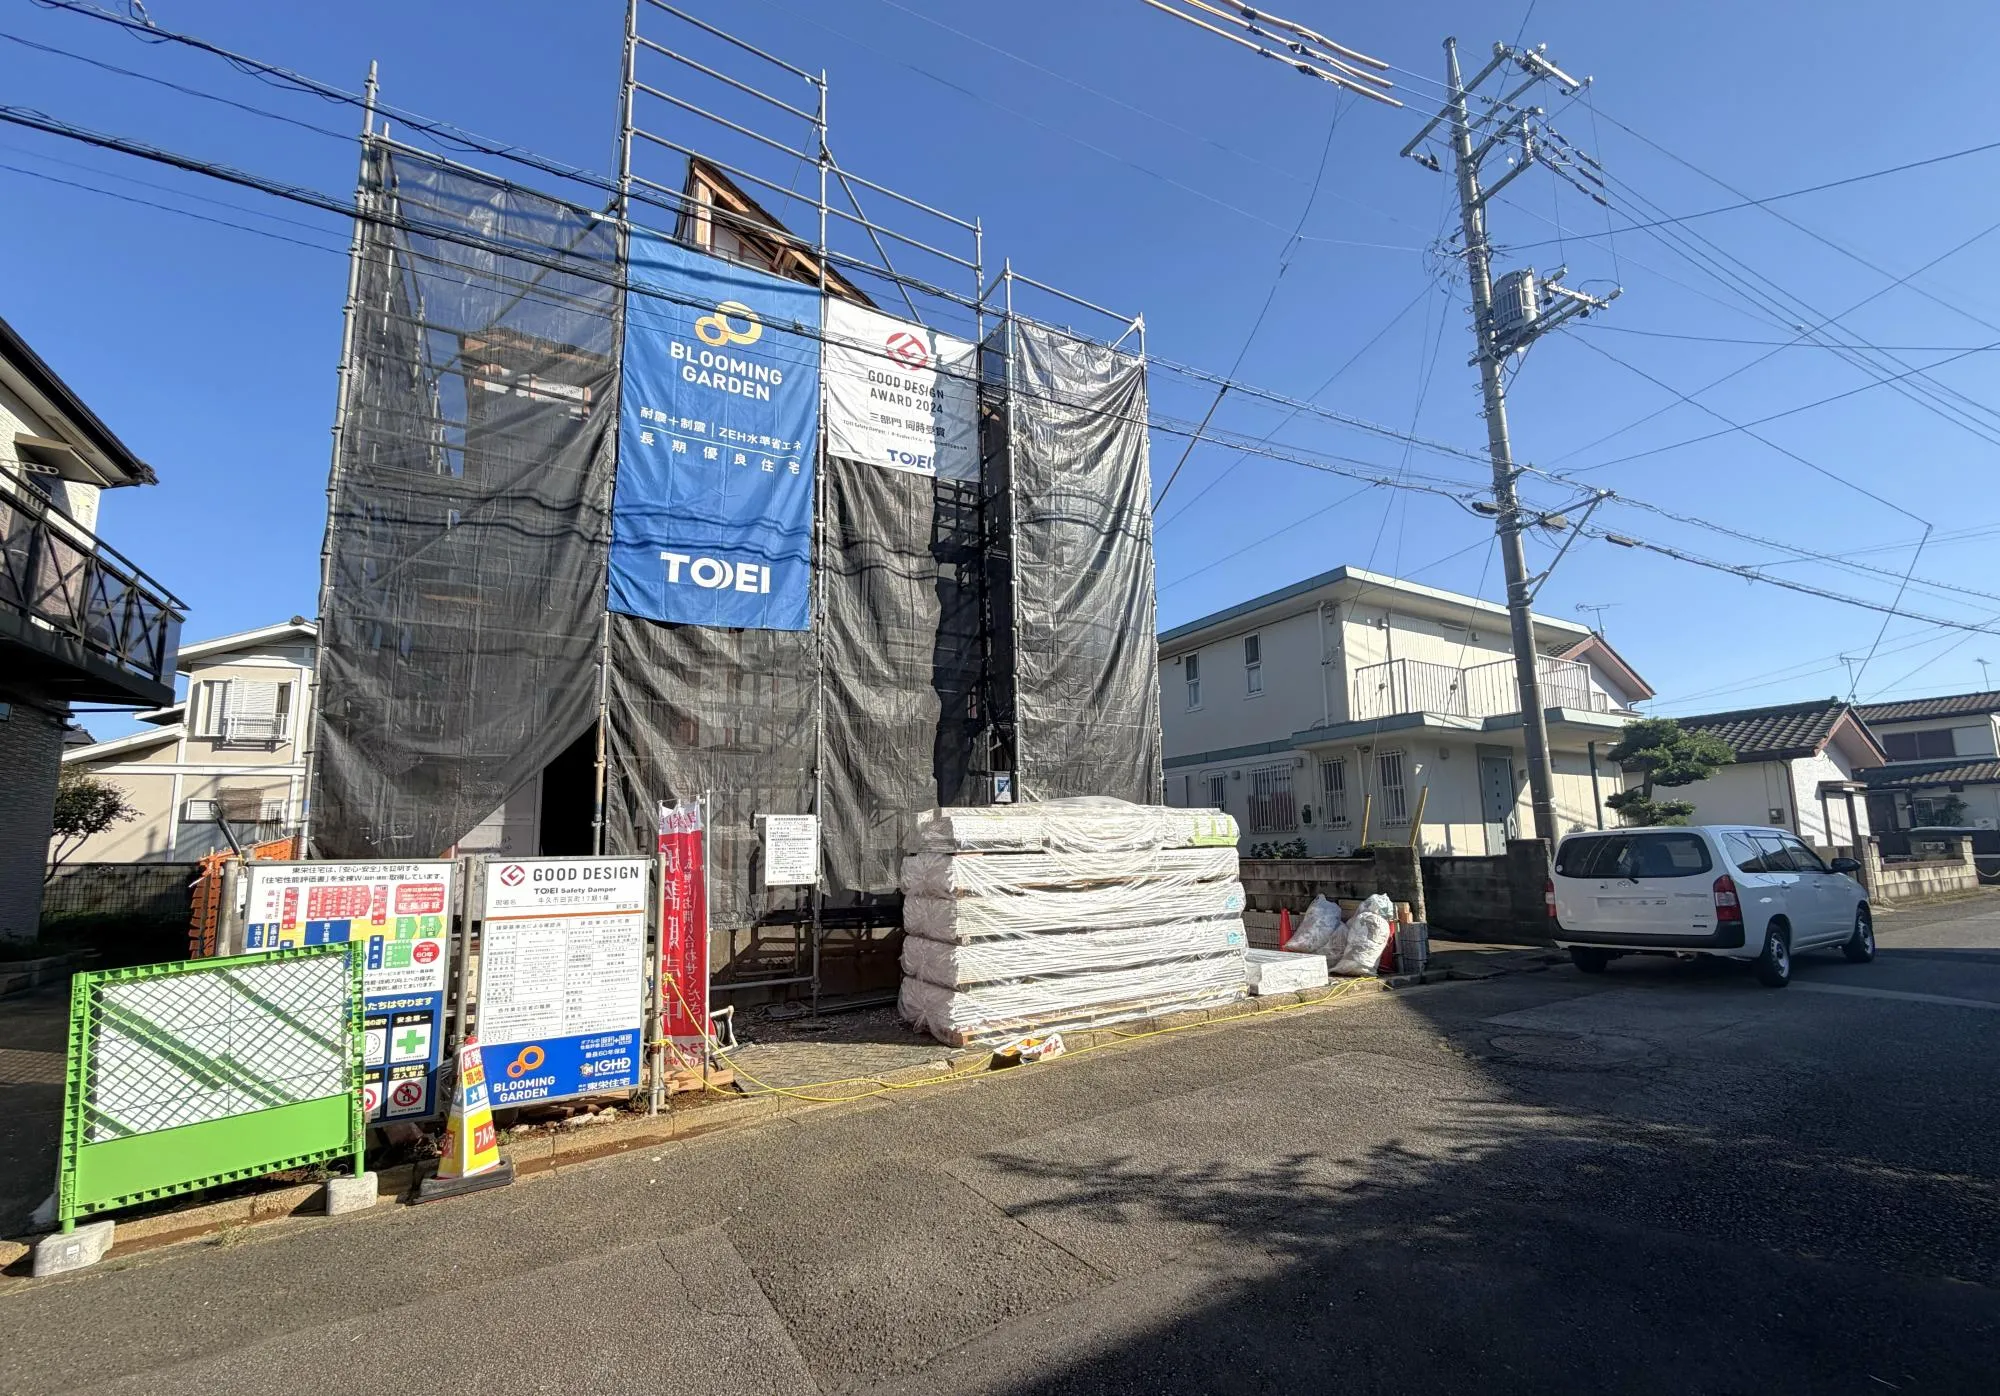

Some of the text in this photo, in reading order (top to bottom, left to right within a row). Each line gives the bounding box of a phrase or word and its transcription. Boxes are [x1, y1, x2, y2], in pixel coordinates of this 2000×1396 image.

[670, 341, 783, 385] BLOOMING
[682, 365, 770, 402] GARDEN
[868, 369, 944, 399] GOOD DESIGN
[870, 387, 943, 414] AWARD 2024
[869, 412, 946, 438] 三部門 同時受賞
[640, 431, 800, 474] 長期優良住宅
[886, 448, 932, 470] TOEI
[660, 551, 771, 594] TOEI
[533, 866, 639, 882] GOOD DESIGN
[533, 887, 559, 895] TOEI
[560, 887, 586, 895] Safety
[594, 1057, 631, 1073] IGHD
[493, 1075, 556, 1093] BLOOMING
[500, 1086, 548, 1102] GARDEN
[586, 1077, 631, 1091] 東栄住宅
